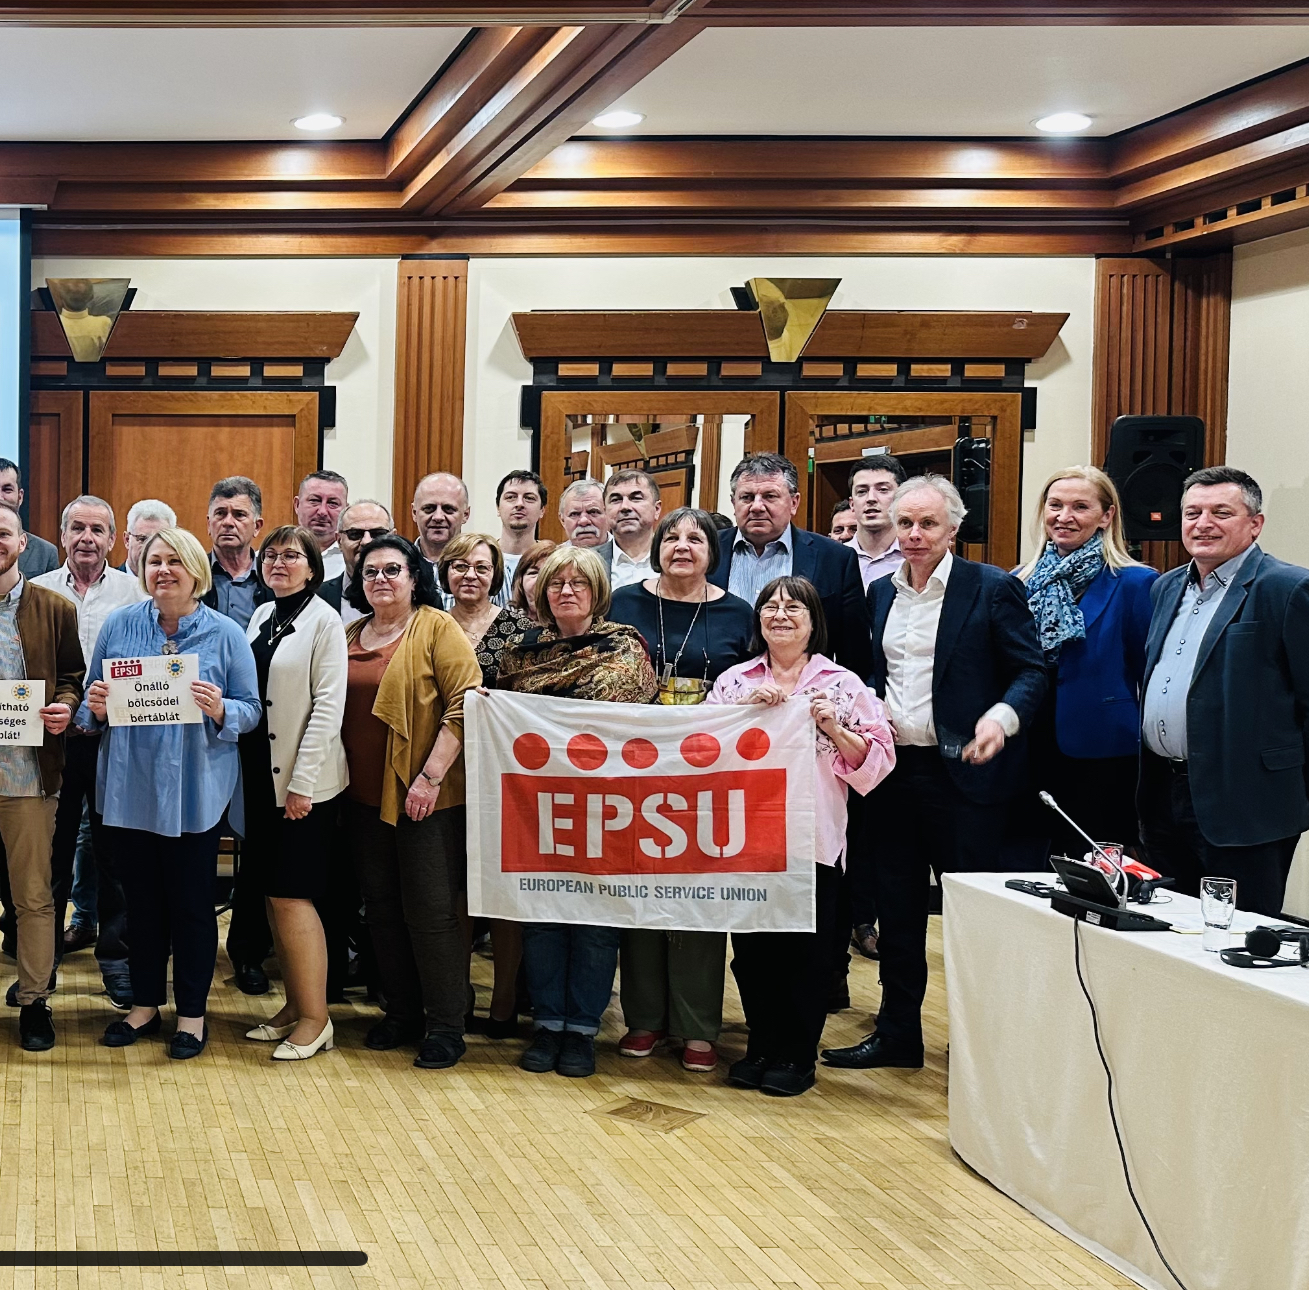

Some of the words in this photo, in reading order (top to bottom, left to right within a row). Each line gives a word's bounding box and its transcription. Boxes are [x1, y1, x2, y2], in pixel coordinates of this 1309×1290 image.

[114, 665, 139, 677] EPSU
[134, 680, 170, 692] Önálló
[130, 711, 181, 723] bértáblát
[537, 789, 746, 859] EPSU
[519, 878, 594, 894] EUROPEAN
[598, 883, 649, 898] PUBLIC
[654, 885, 715, 900] SERVICE
[720, 887, 767, 901] UNION
